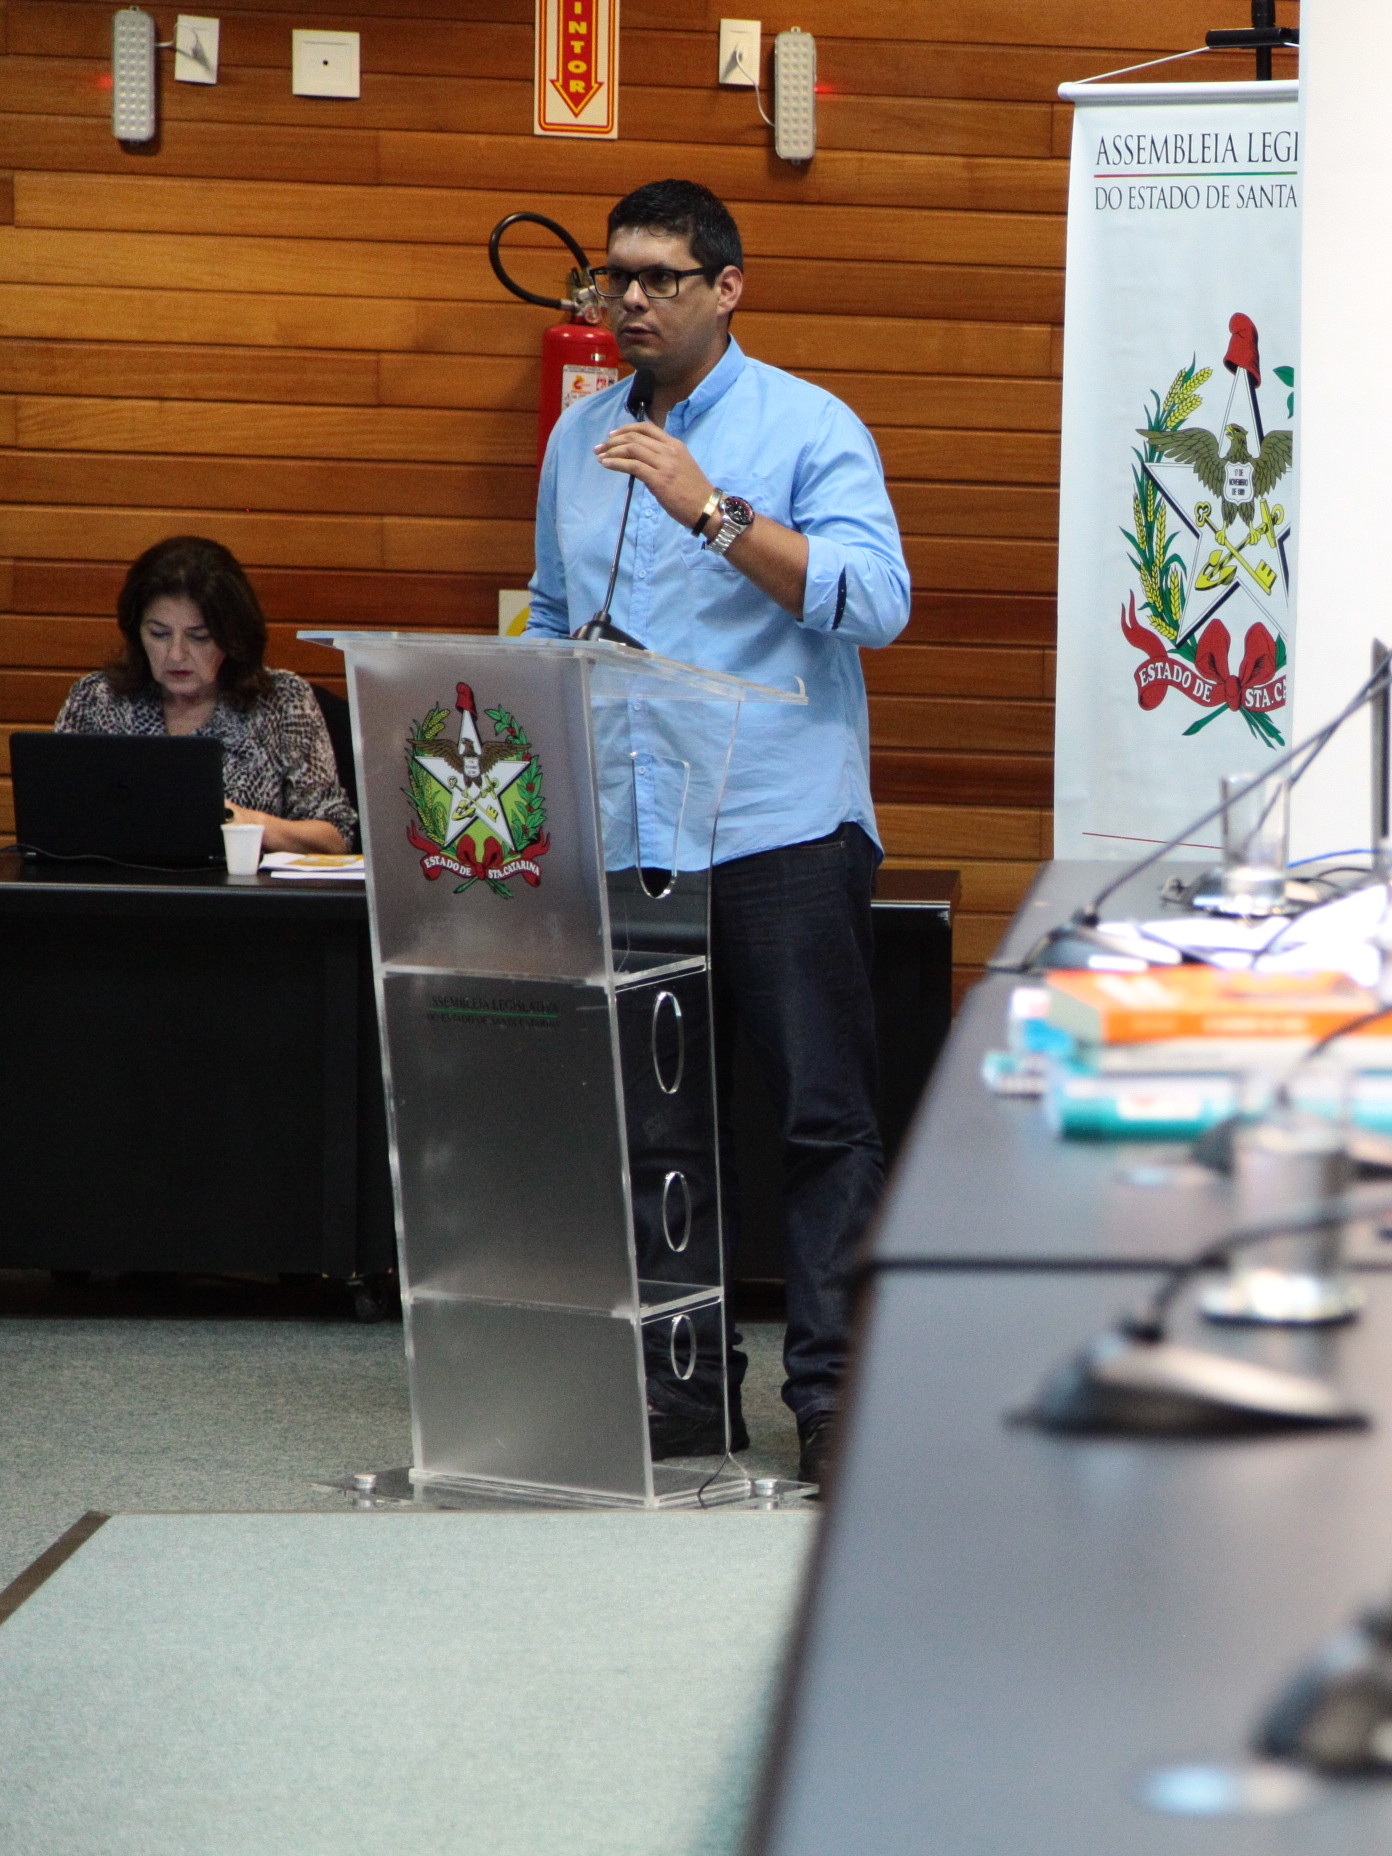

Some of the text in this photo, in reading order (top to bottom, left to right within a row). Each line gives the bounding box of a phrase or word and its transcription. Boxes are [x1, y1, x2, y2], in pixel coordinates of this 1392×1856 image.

[1095, 130, 1298, 166] ASSEMBLEIA LEGI
[1094, 183, 1298, 210] DO ESTADO DE SANTA
[1138, 662, 1192, 689] ESTADO
[1192, 678, 1213, 703] DE
[423, 855, 459, 871] ESTADO
[459, 865, 472, 877] DE
[431, 995, 490, 1009] SSEMBLEIA
